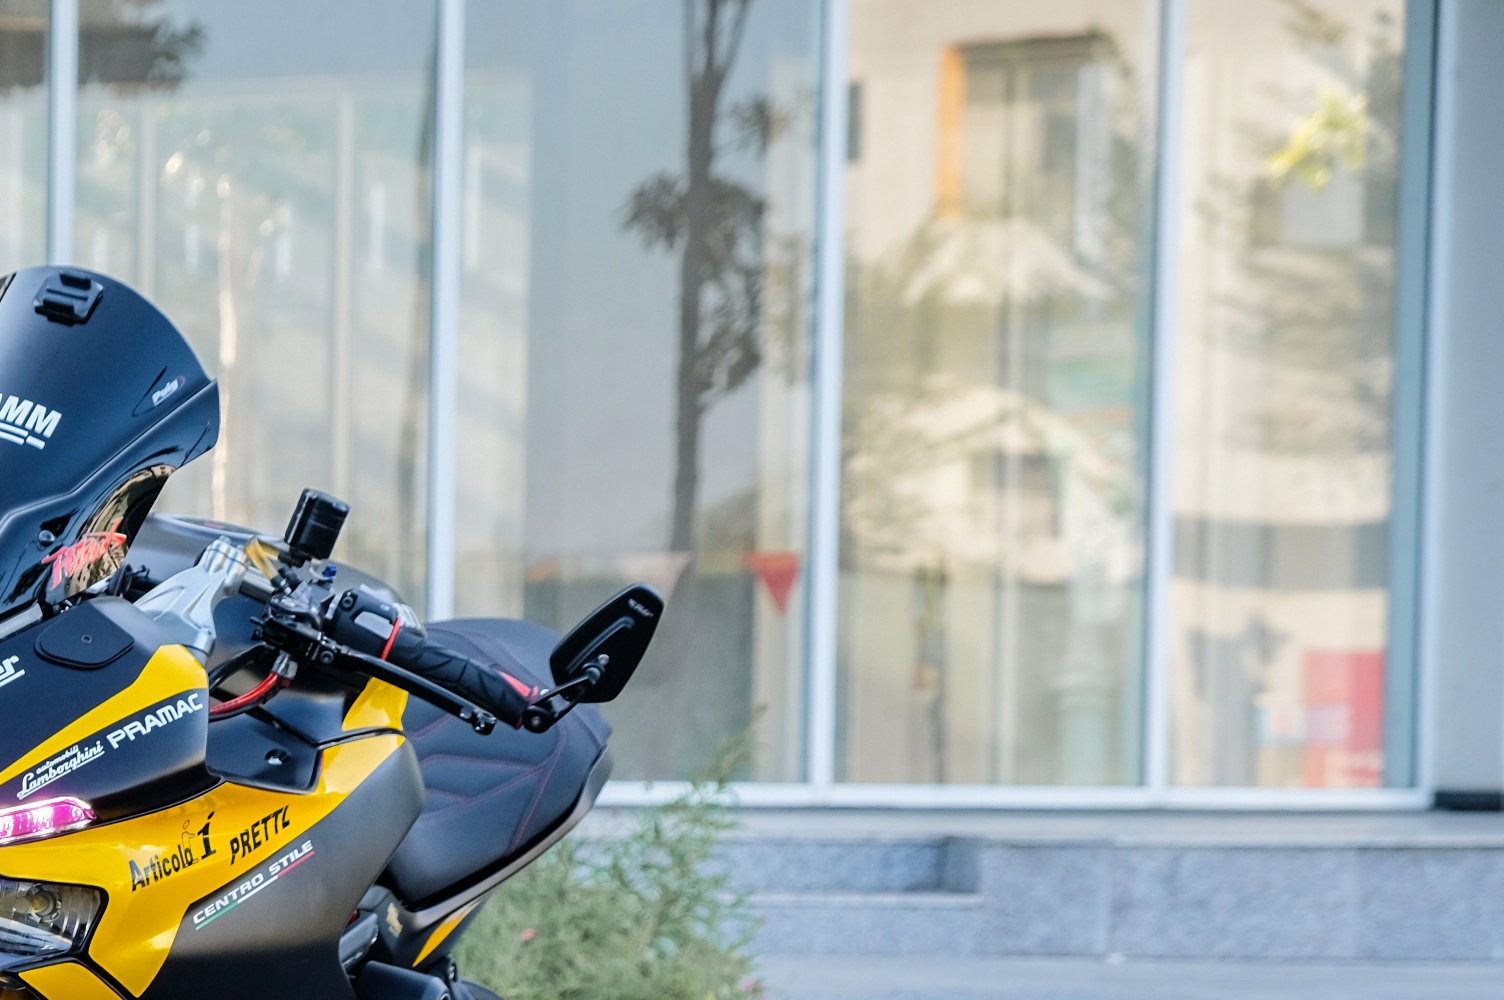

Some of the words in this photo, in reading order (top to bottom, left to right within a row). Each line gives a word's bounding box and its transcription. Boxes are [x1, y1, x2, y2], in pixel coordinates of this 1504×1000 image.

[106, 692, 204, 750] PRAMAC
[17, 741, 105, 798] Lamborghini
[193, 871, 264, 925] CENTRO
[268, 840, 315, 879] STILE
